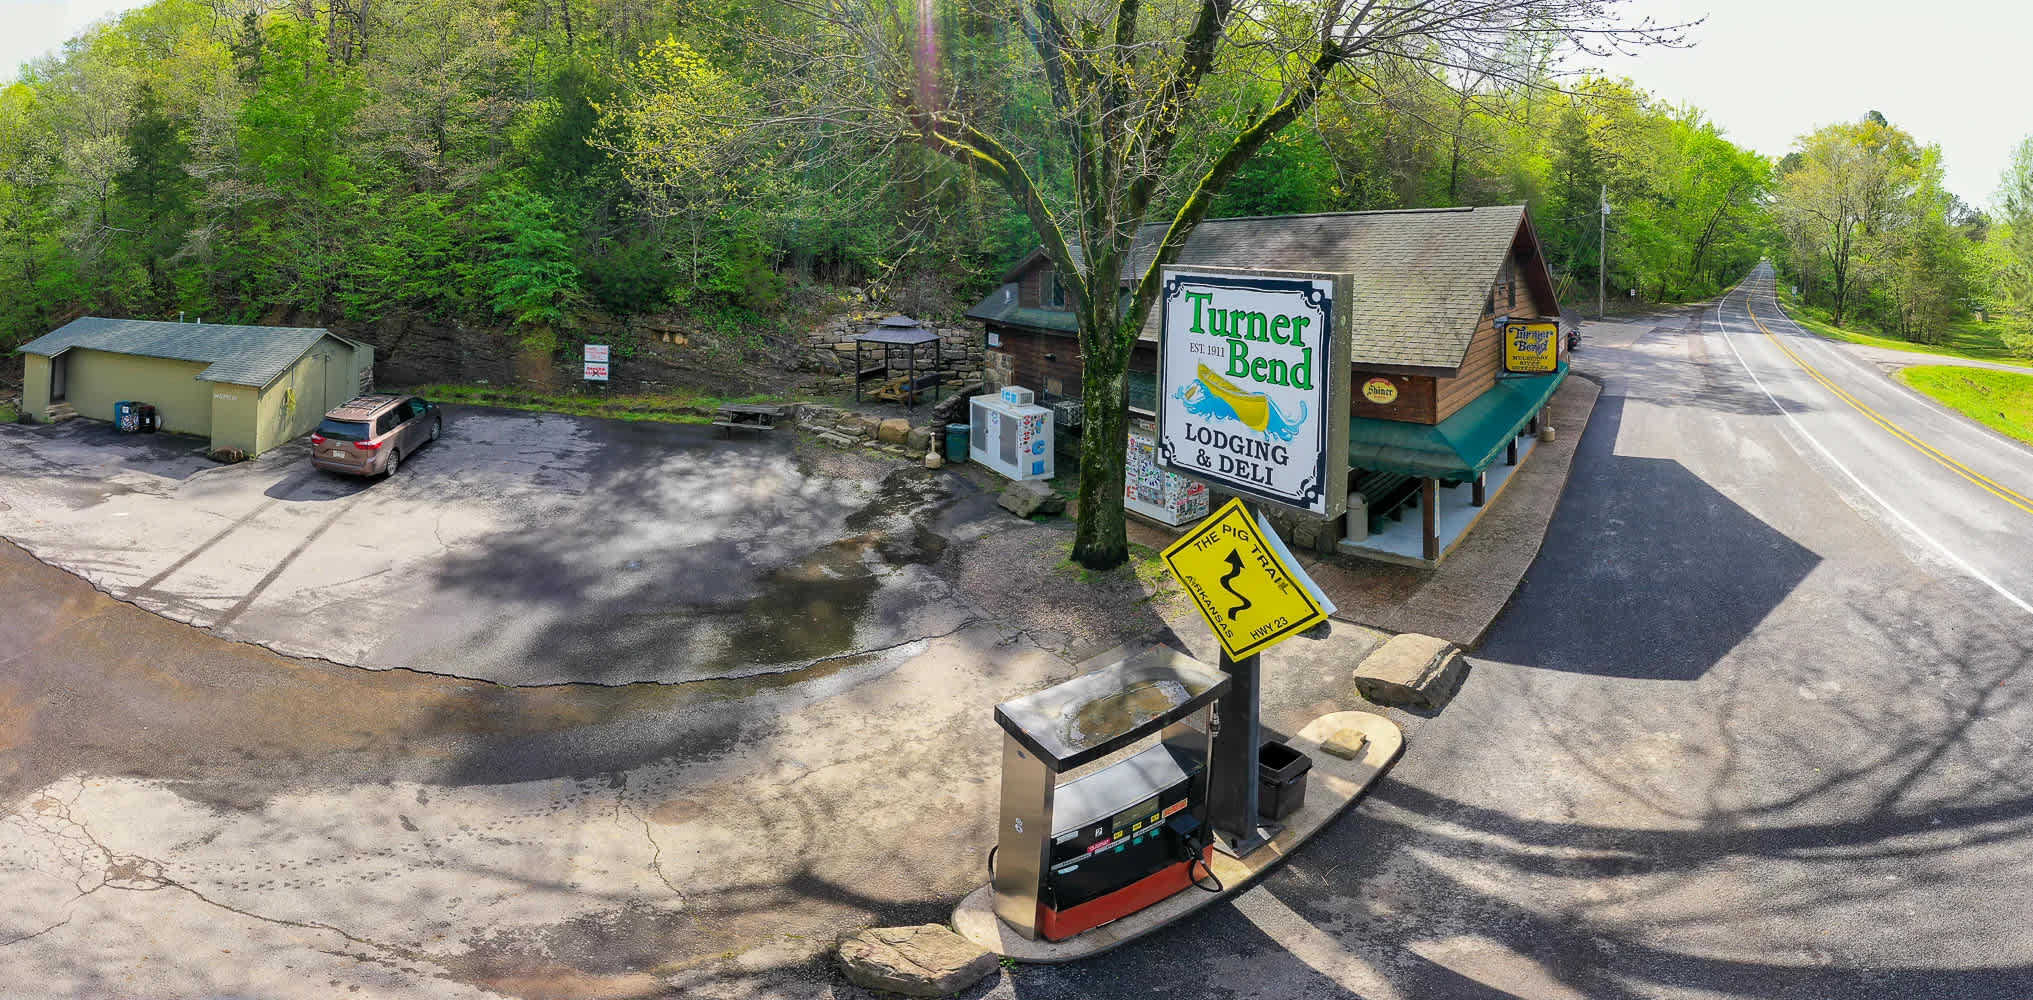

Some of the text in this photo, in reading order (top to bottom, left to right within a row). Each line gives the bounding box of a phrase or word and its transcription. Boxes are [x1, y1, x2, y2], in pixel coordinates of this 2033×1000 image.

[1185, 290, 1311, 347] Turner
[1190, 343, 1225, 357] EST. 1911
[1226, 338, 1313, 390] Bend
[1185, 423, 1289, 466] LODGING
[1196, 448, 1274, 486] & DELI
[1193, 523, 1289, 596] THE PIG TRAIL
[1185, 575, 1234, 639] ARKANSAS
[1250, 616, 1289, 641] HWY 23
